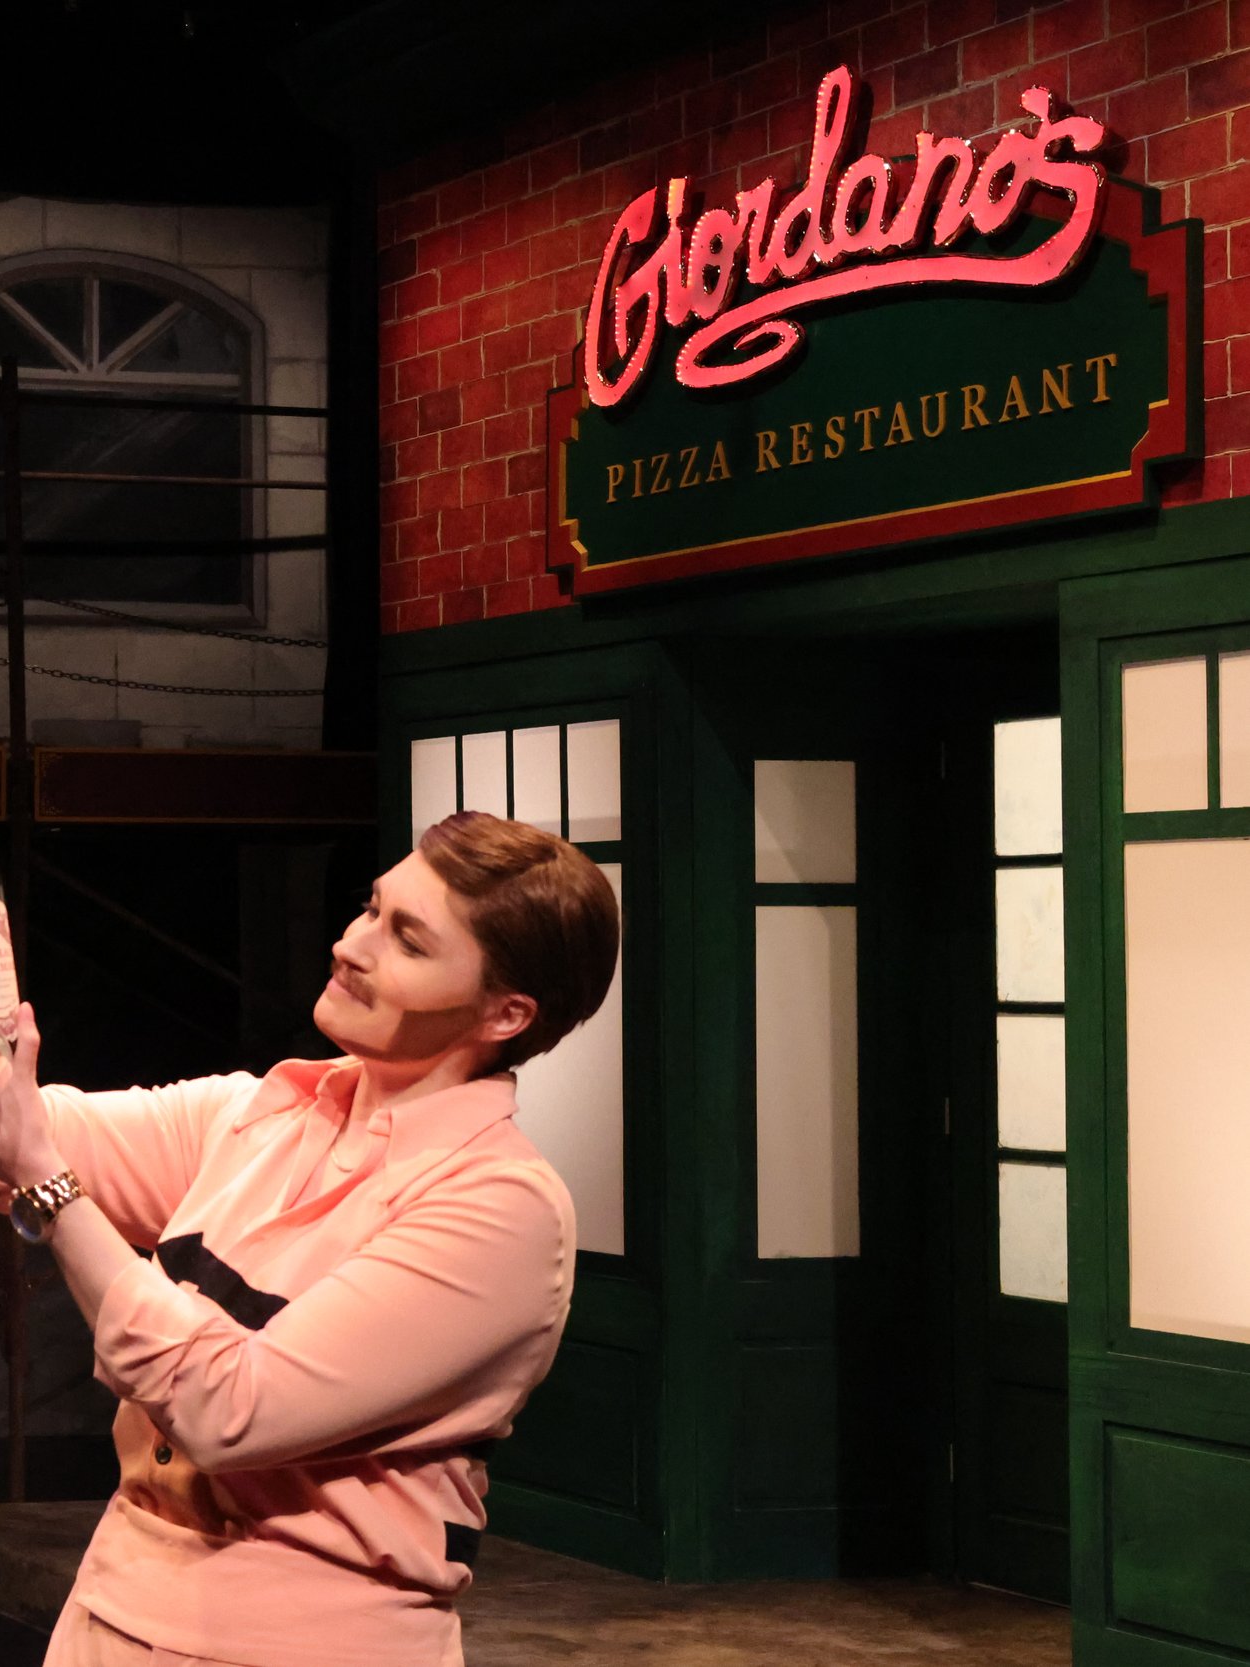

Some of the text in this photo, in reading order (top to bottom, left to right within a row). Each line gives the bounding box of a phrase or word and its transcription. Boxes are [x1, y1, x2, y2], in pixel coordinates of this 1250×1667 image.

[584, 64, 1105, 408] Giordano's
[606, 353, 1118, 503] PIZZA RESTAURANT
